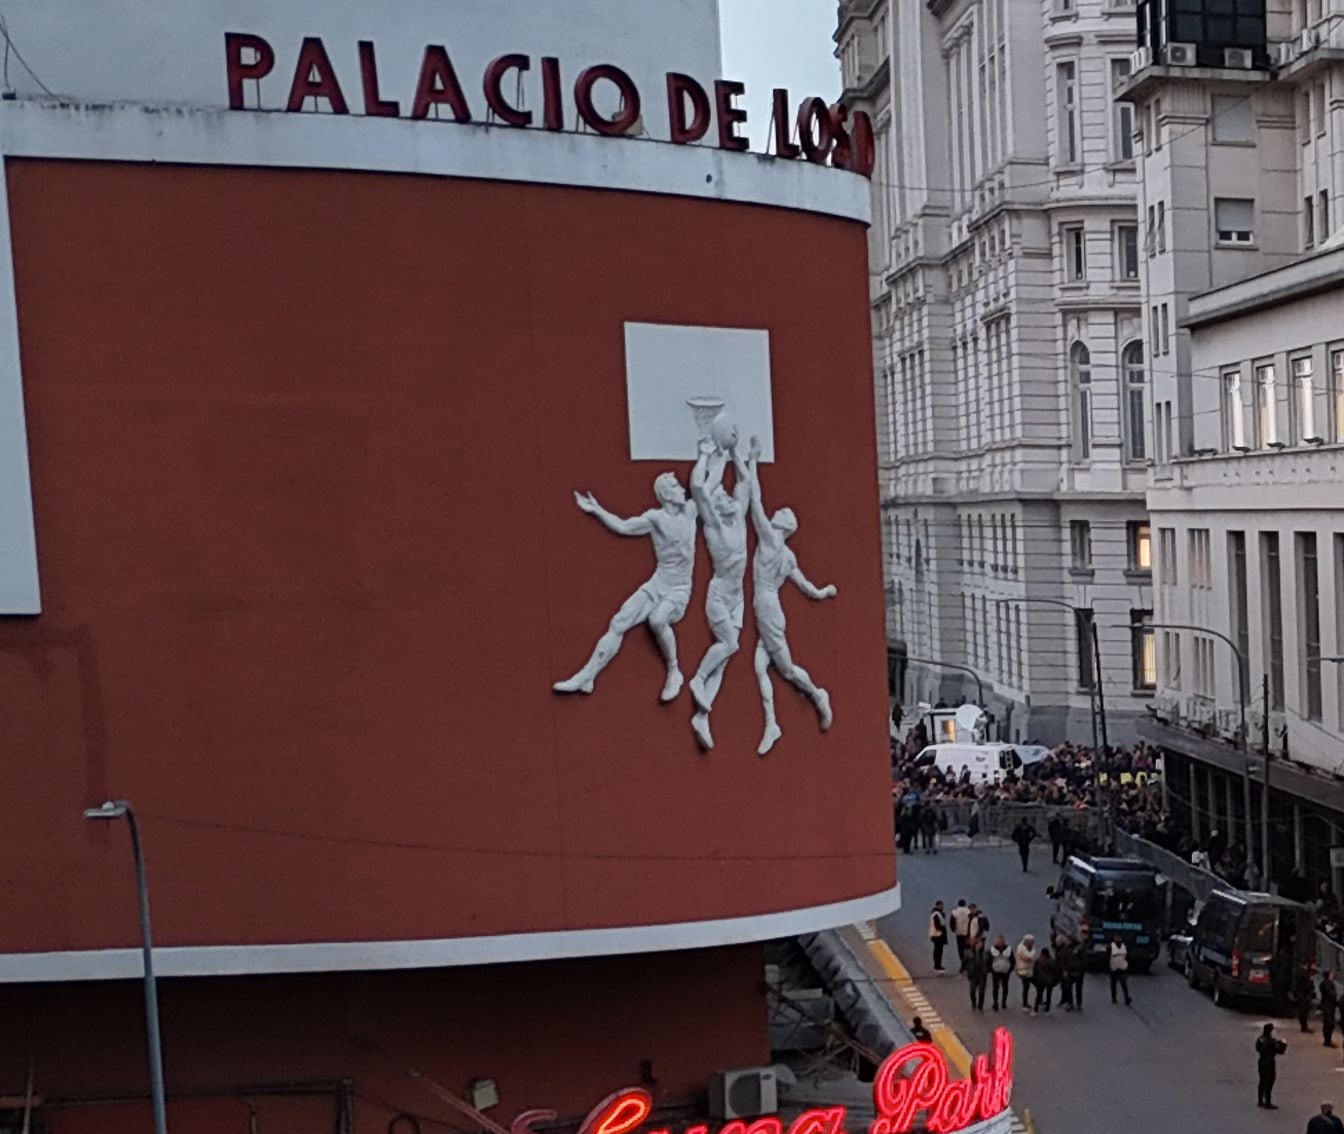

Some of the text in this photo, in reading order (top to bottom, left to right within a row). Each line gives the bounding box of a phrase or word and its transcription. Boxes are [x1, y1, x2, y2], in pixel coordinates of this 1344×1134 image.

[224, 31, 641, 138] PALACIO
[666, 72, 751, 153] DE
[773, 88, 850, 170] LOS
